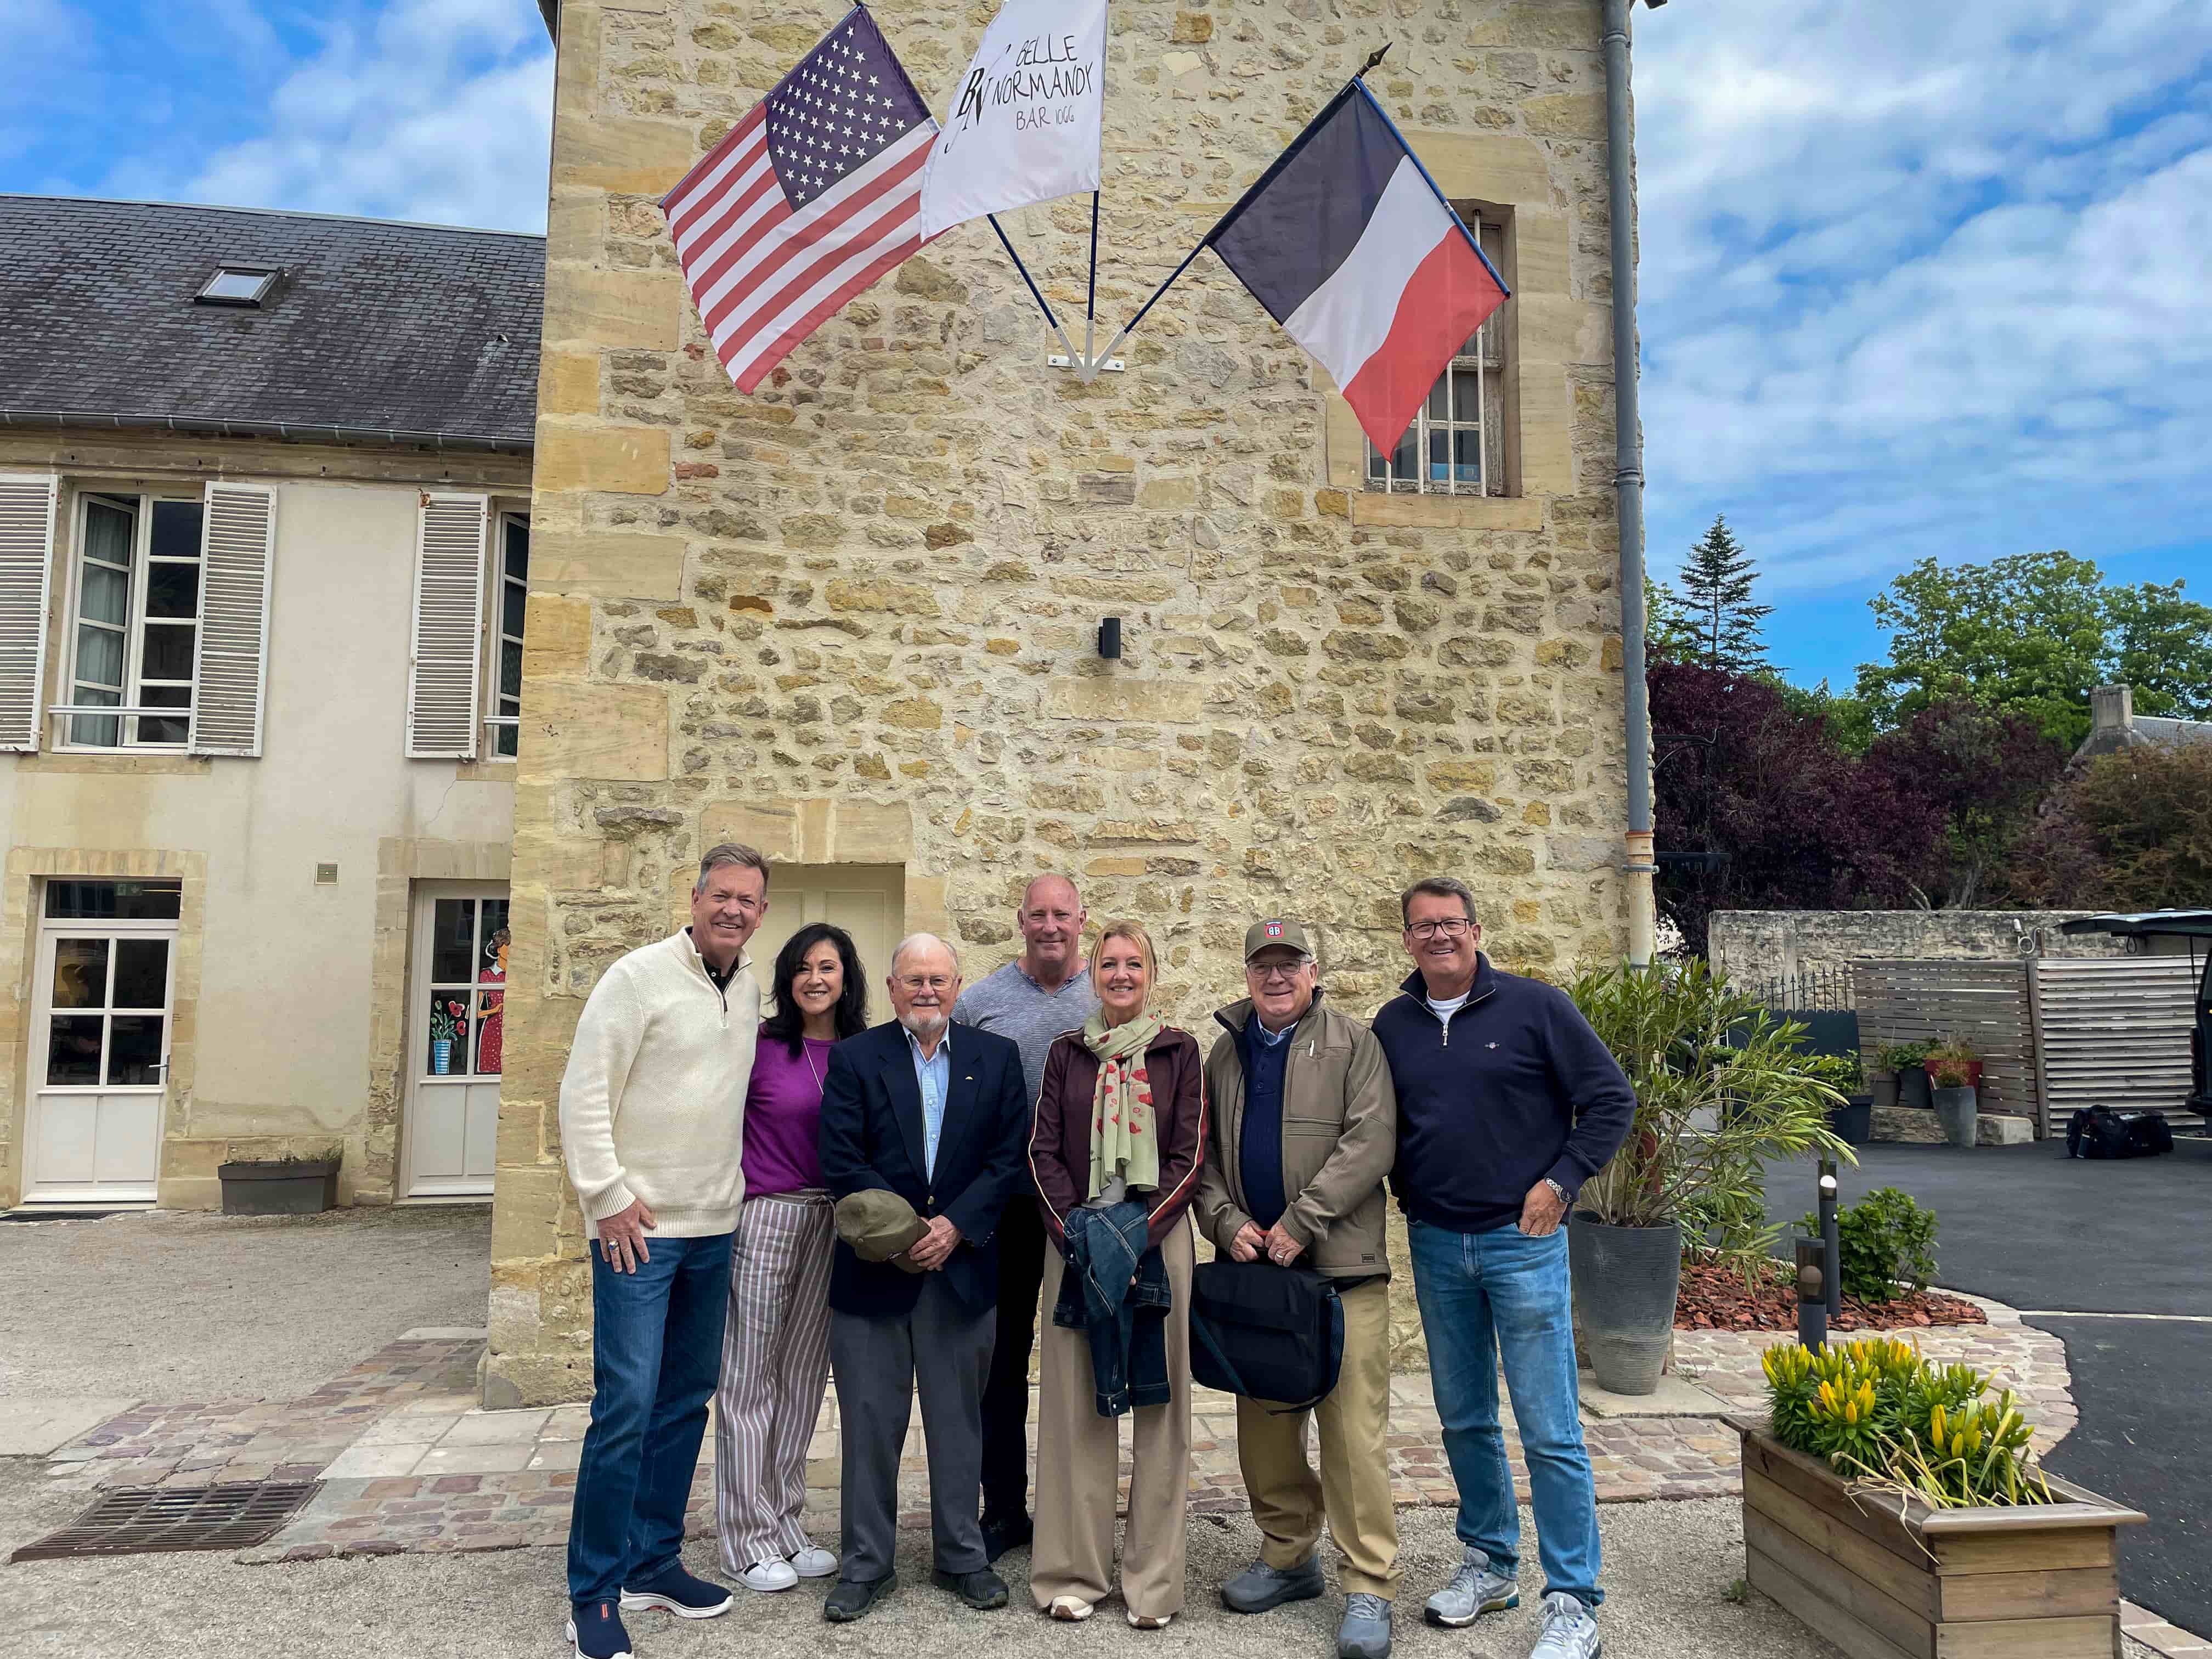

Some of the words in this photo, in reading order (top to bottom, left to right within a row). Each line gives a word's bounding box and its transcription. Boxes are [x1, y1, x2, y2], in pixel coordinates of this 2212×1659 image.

[1015, 33, 1077, 66] BELLE
[992, 61, 1093, 106] NORMANDY
[1016, 106, 1051, 130] BAR
[1056, 105, 1074, 125] 1066
